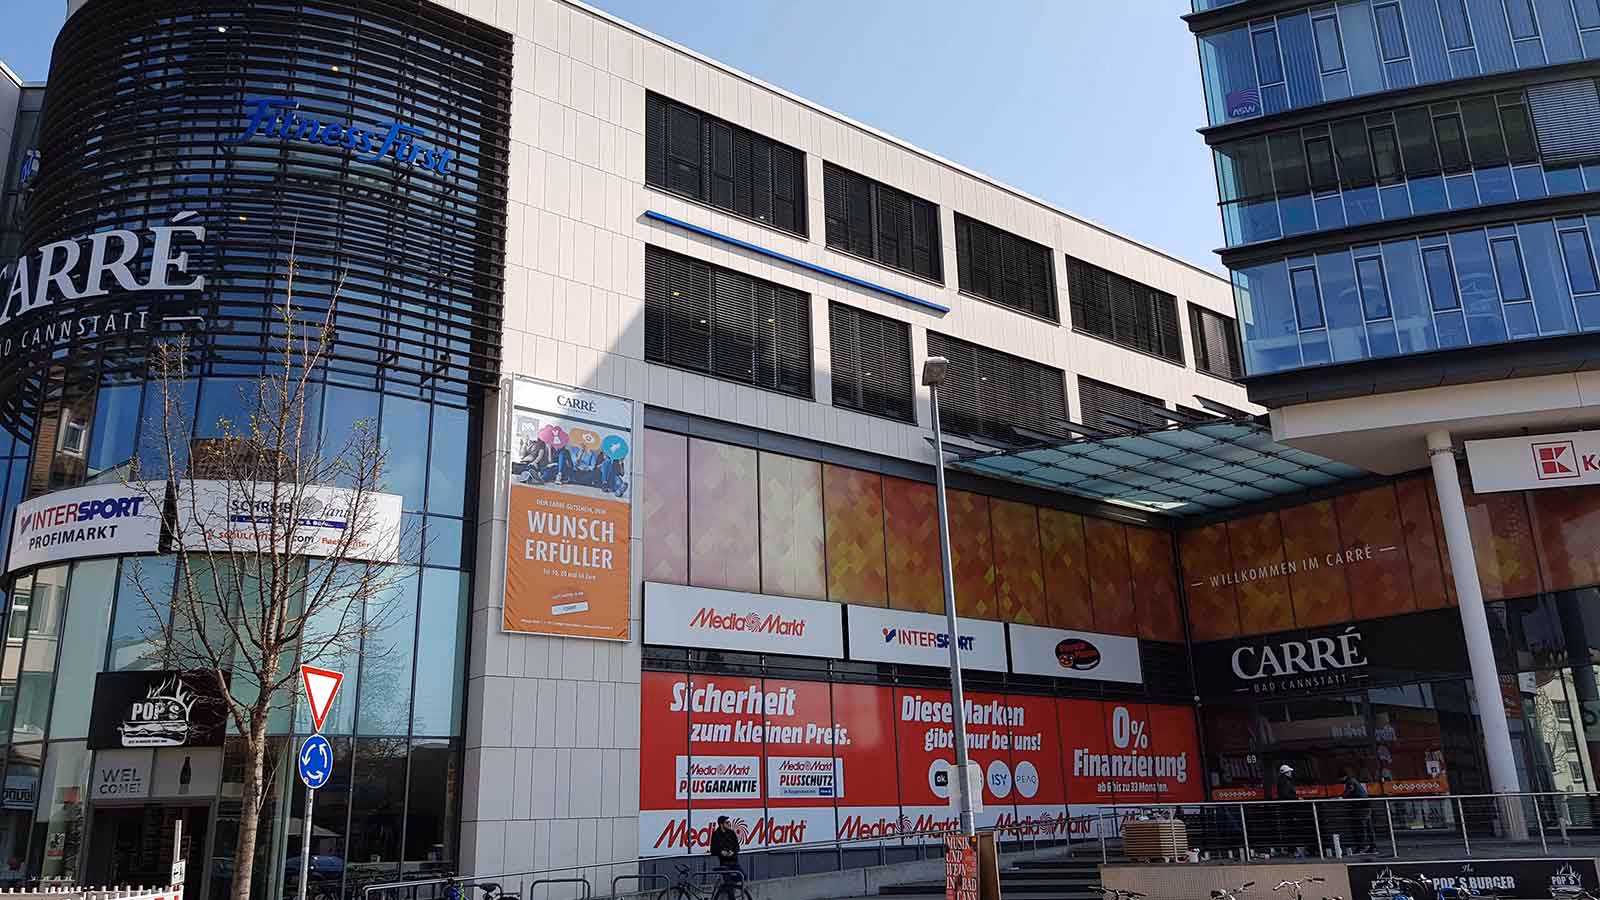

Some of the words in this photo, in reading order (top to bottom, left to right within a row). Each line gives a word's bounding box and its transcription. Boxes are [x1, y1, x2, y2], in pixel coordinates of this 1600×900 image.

[0, 211, 206, 326] ARRÉ
[21, 311, 149, 349] CANNSTATT
[1582, 454, 1600, 472] K
[32, 496, 145, 532] INTERSPORT
[527, 510, 615, 544] WUNSCH
[29, 525, 118, 551] PROFIMARKT
[524, 539, 613, 570] ERFÜLLER
[1209, 561, 1297, 588] WILLKOMMEN
[1302, 557, 1319, 571] IM
[1326, 544, 1372, 567] CARRÉ
[690, 607, 746, 632] Media
[757, 614, 805, 637] Markt
[898, 629, 976, 652] INTERSPRT
[1232, 626, 1368, 680] CARRÉ
[1253, 682, 1276, 693] BAD
[1281, 674, 1348, 690] CANNSTATT
[669, 681, 797, 716] Sicherheit
[901, 695, 953, 722] Diese
[690, 722, 732, 743] zum
[733, 720, 803, 744] kleinen
[805, 723, 852, 745] Preis.
[966, 732, 990, 749] nur
[1014, 732, 1042, 751] uns!
[1074, 748, 1187, 784] Finanzierung
[779, 774, 833, 787] PLUSSCHUTZ
[992, 773, 1008, 786] ISY
[653, 817, 718, 849] Medi
[744, 816, 806, 846] Markt
[944, 835, 970, 850] MUSIK
[946, 850, 963, 863] UND
[946, 863, 967, 877] WEIN
[946, 876, 956, 889] IN
[962, 877, 977, 891] BAD
